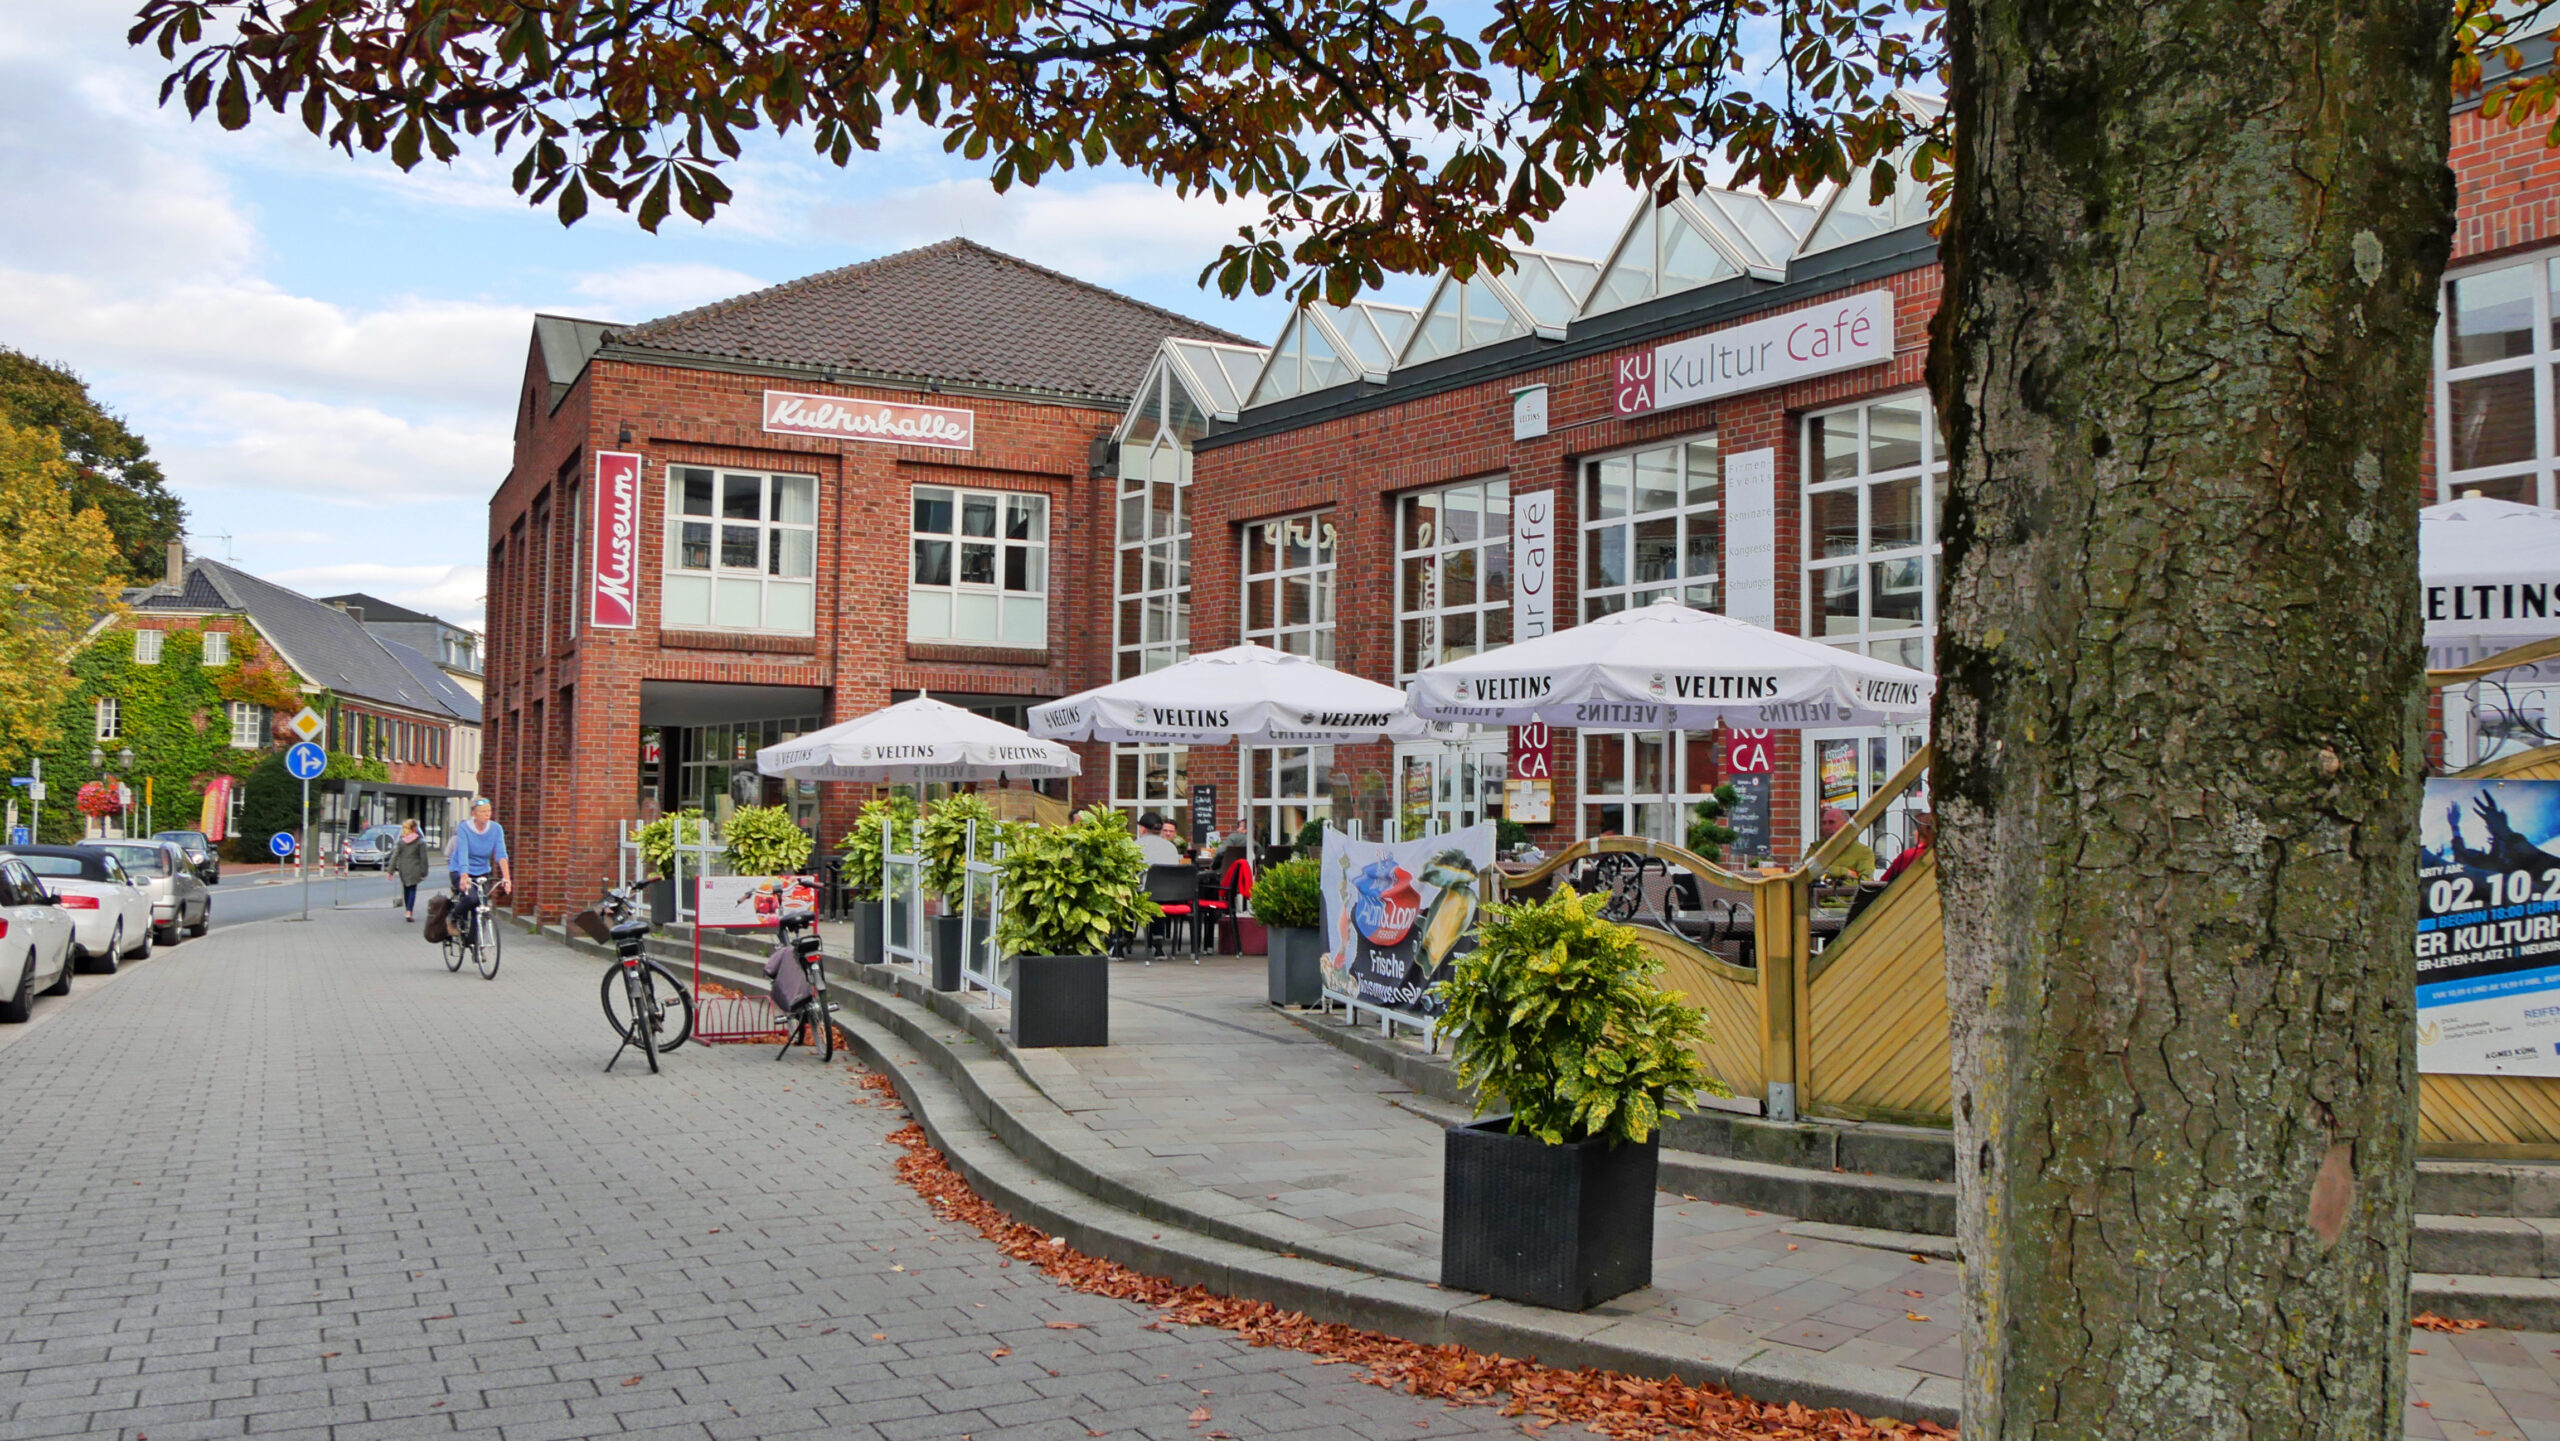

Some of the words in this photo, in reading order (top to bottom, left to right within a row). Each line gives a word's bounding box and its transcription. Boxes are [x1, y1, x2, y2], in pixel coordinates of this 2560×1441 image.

[1663, 340, 1774, 394] Kultur
[1787, 306, 1871, 361] Café
[1620, 352, 1652, 385] KU
[1618, 384, 1652, 413] CA
[769, 399, 969, 442] Kulturhalle
[1728, 473, 1772, 489] Events
[1728, 507, 1772, 523] Seminare
[598, 466, 633, 617] Museum
[1521, 503, 1546, 595] Café
[1728, 542, 1772, 559] Kongresse
[1728, 576, 1772, 593] Schulungen
[1475, 676, 1552, 701] VELTINS
[1675, 676, 1778, 699] VELTINS
[1867, 679, 1919, 705] VELTINS
[1050, 706, 1080, 729] VELTINS
[1153, 708, 1229, 728] VELTINS
[1320, 712, 1391, 727] VELTINS
[1519, 724, 1548, 750] KU
[782, 748, 812, 765] VELTINS
[876, 745, 935, 760] VELTINS
[999, 746, 1048, 760] VELTINS
[1518, 752, 1548, 778] CA
[1732, 743, 1770, 772] CA
[2438, 909, 2488, 929] BEGINN
[2490, 904, 2525, 921] 18:00
[2526, 900, 2556, 915] UHR
[1369, 949, 1406, 979] Frische
